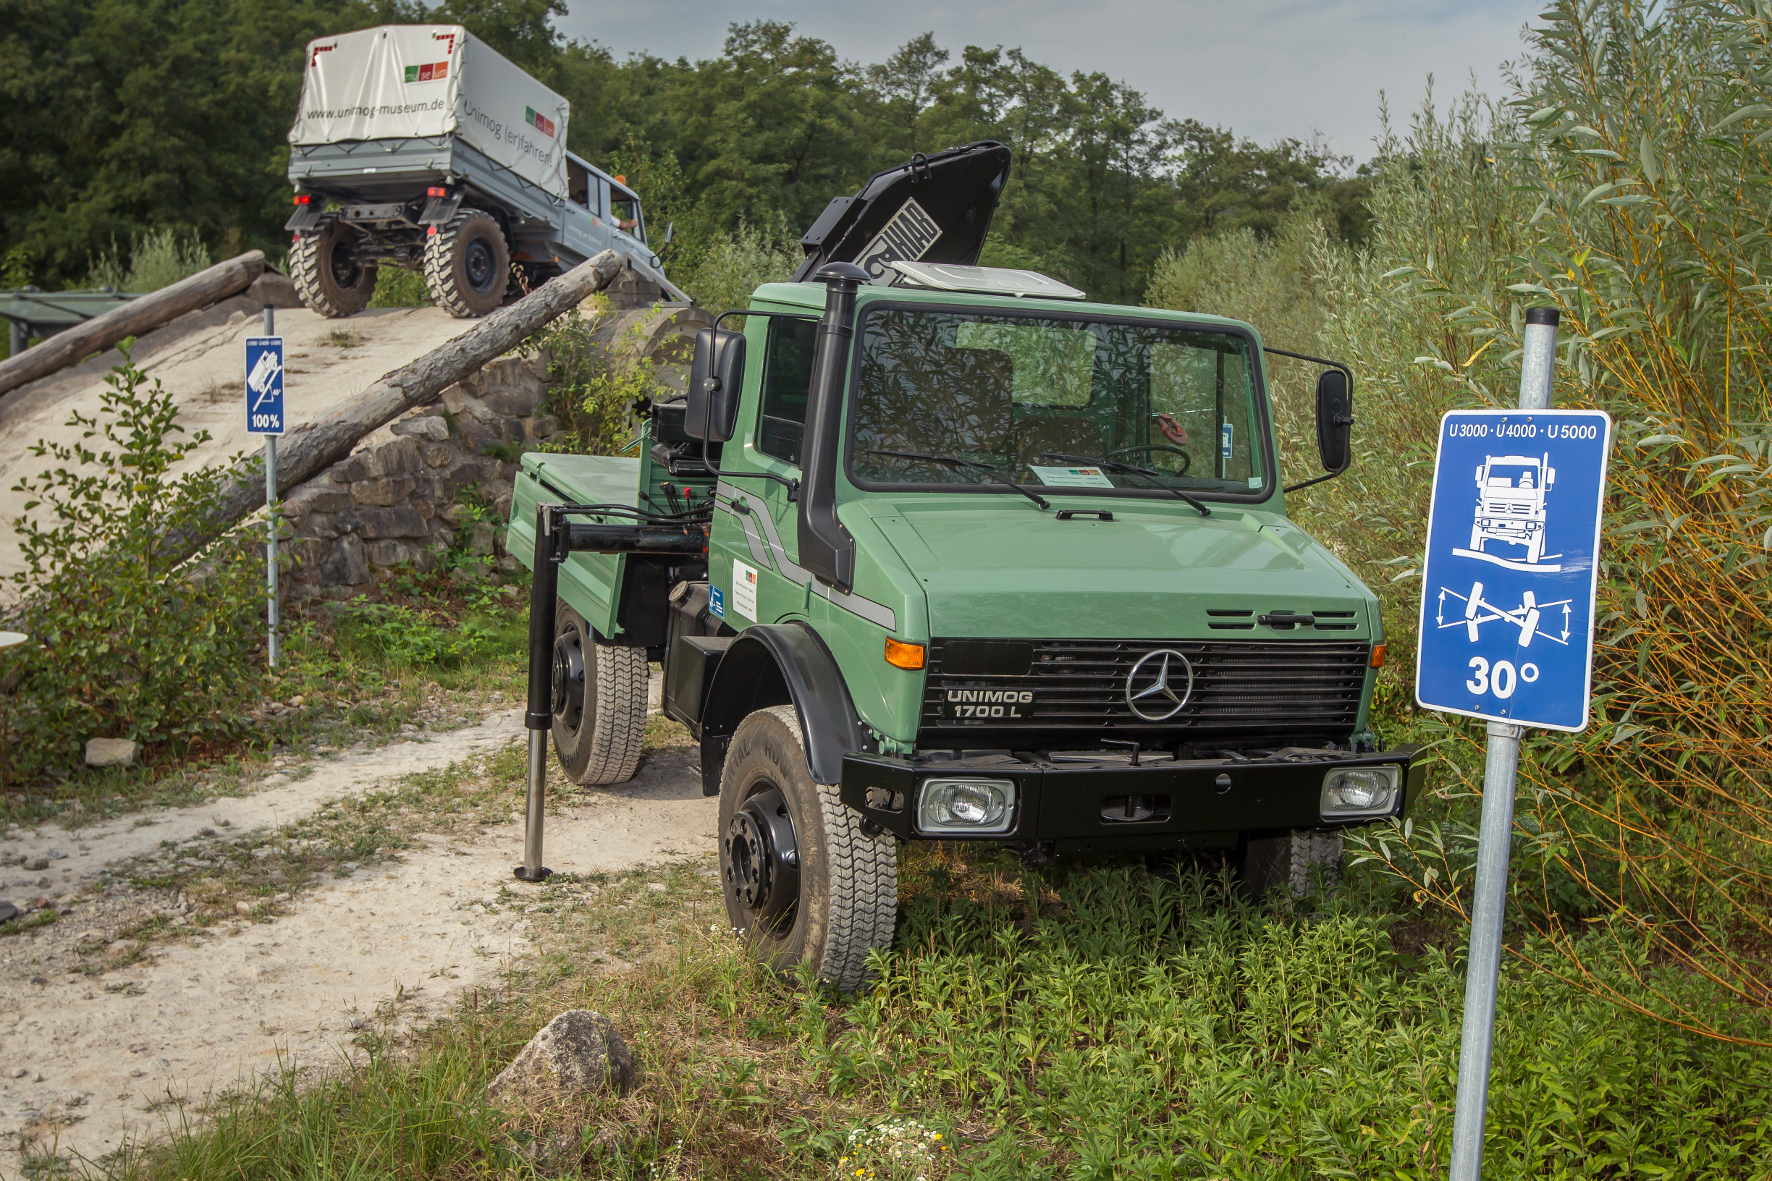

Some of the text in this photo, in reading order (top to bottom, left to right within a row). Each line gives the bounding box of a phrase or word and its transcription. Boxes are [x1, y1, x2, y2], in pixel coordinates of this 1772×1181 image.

[307, 98, 445, 119] www.unimog-museum.de
[464, 98, 501, 140] Unimog
[881, 203, 939, 261] HIAB
[1466, 656, 1540, 699] 30°
[947, 690, 1033, 704] UNIMOG
[954, 705, 1022, 718] 1700 L
